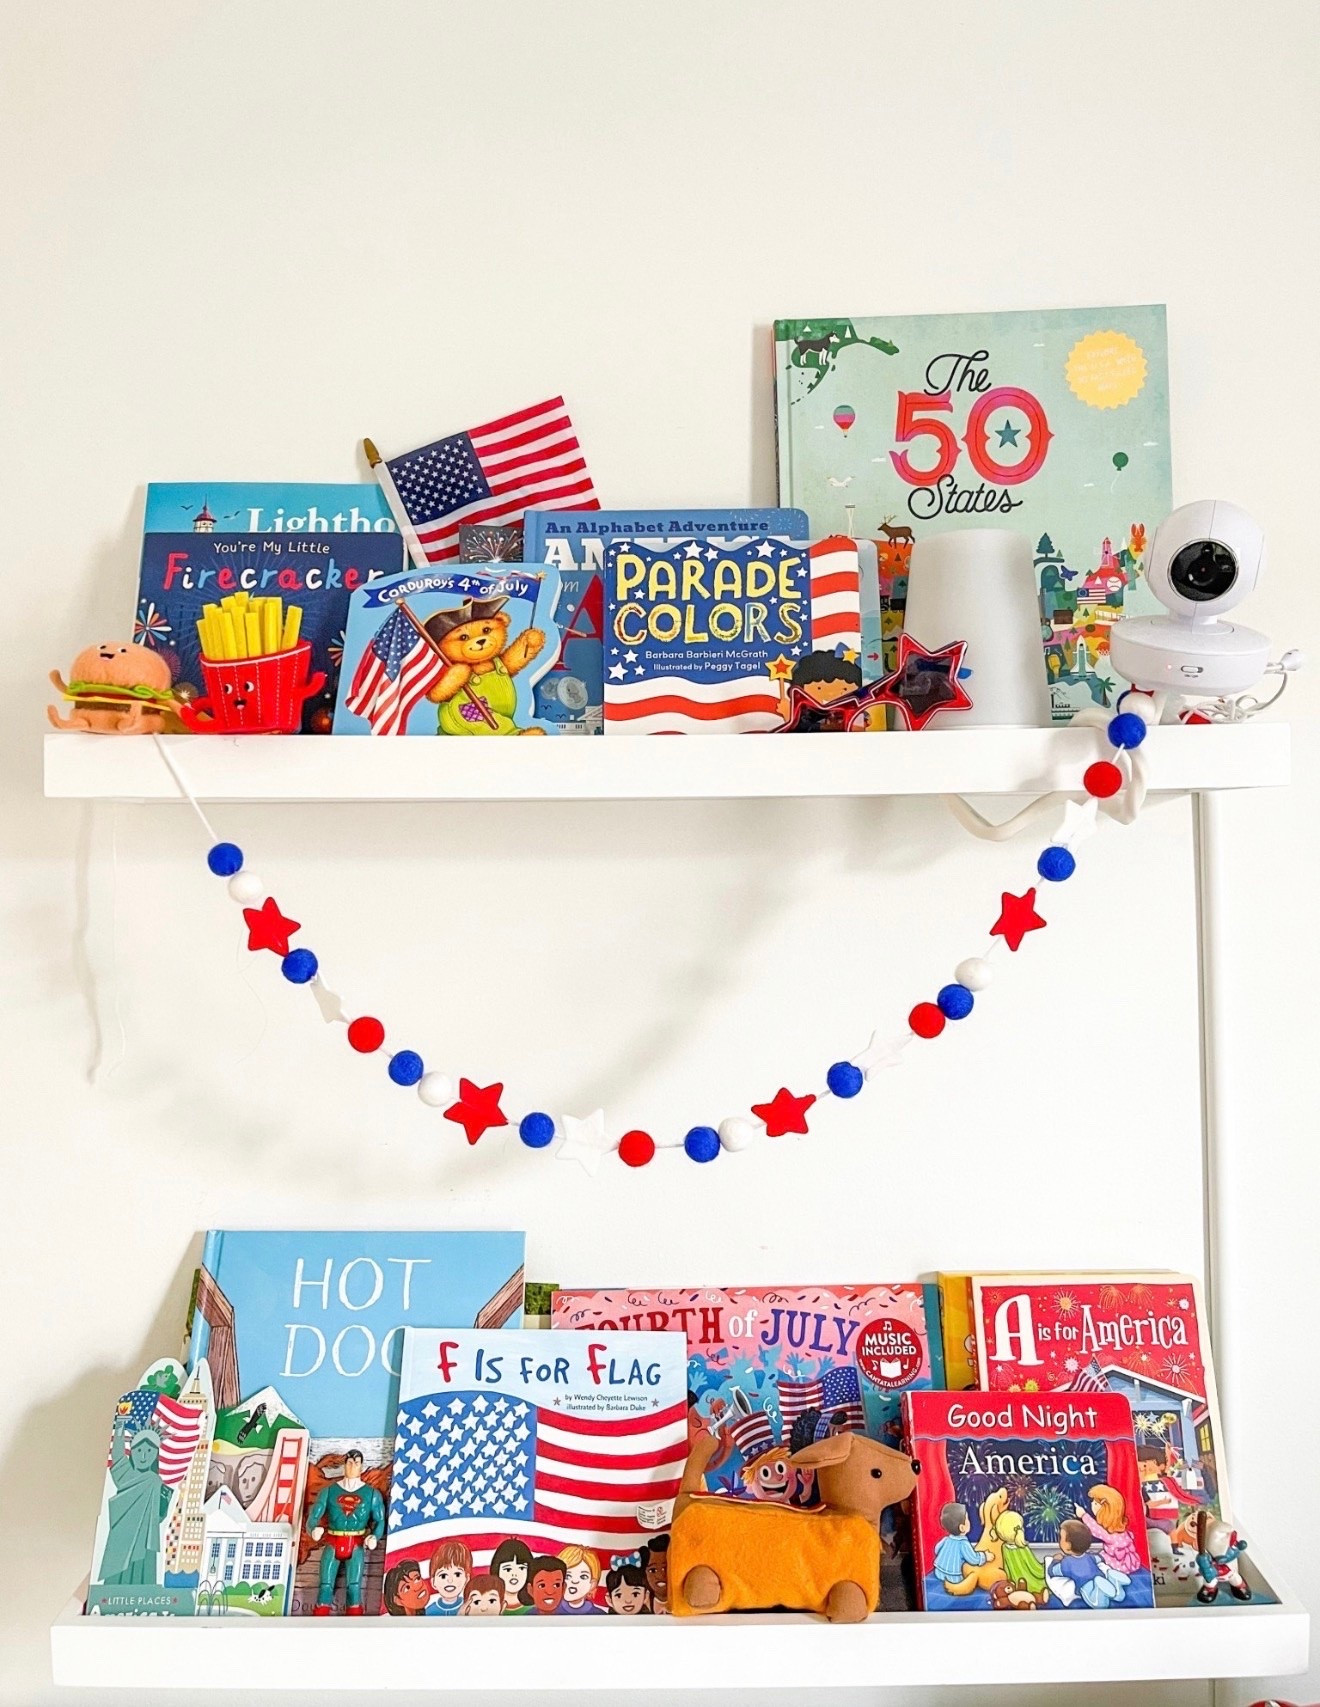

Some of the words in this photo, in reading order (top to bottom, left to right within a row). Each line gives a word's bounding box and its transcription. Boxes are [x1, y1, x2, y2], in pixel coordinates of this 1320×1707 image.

[924, 350, 992, 396] The
[889, 386, 1055, 487] 50
[907, 474, 1023, 520] States
[545, 522, 572, 533] An
[576, 521, 663, 535] Alphabet
[668, 520, 769, 533] Adventure
[214, 542, 256, 554] You're
[263, 541, 281, 555] My
[288, 541, 330, 554] Little
[480, 584, 495, 595] of
[497, 580, 528, 597] July
[616, 553, 802, 601] PARADE
[613, 602, 802, 645] COLORS
[645, 651, 684, 659] Barbara
[686, 651, 724, 659] Barbieri
[726, 650, 768, 659] McGrath
[653, 663, 693, 671] Illustrated
[693, 663, 703, 671] by
[704, 662, 733, 672] Peggy
[735, 662, 760, 672] Tagel
[293, 1257, 432, 1311] HOT
[728, 1310, 759, 1338] of
[760, 1308, 860, 1356] JULY
[864, 1333, 912, 1345] MUSIC
[989, 1294, 1045, 1366] A
[1037, 1322, 1052, 1341] is
[1054, 1322, 1080, 1341] for
[1079, 1304, 1190, 1355] America
[437, 1341, 460, 1383] F
[475, 1348, 504, 1383] IS
[586, 1343, 661, 1385] FLAG
[862, 1345, 917, 1356] INCLUDED
[566, 1403, 596, 1411] illustrated
[597, 1403, 605, 1411] by
[574, 1394, 595, 1402] Wendy
[596, 1394, 622, 1402] Cheyette
[947, 1403, 1013, 1428] Good
[1022, 1403, 1098, 1436] Night
[958, 1445, 1098, 1476] America
[108, 1597, 136, 1605] LITTLE
[137, 1596, 171, 1605] PLACES
